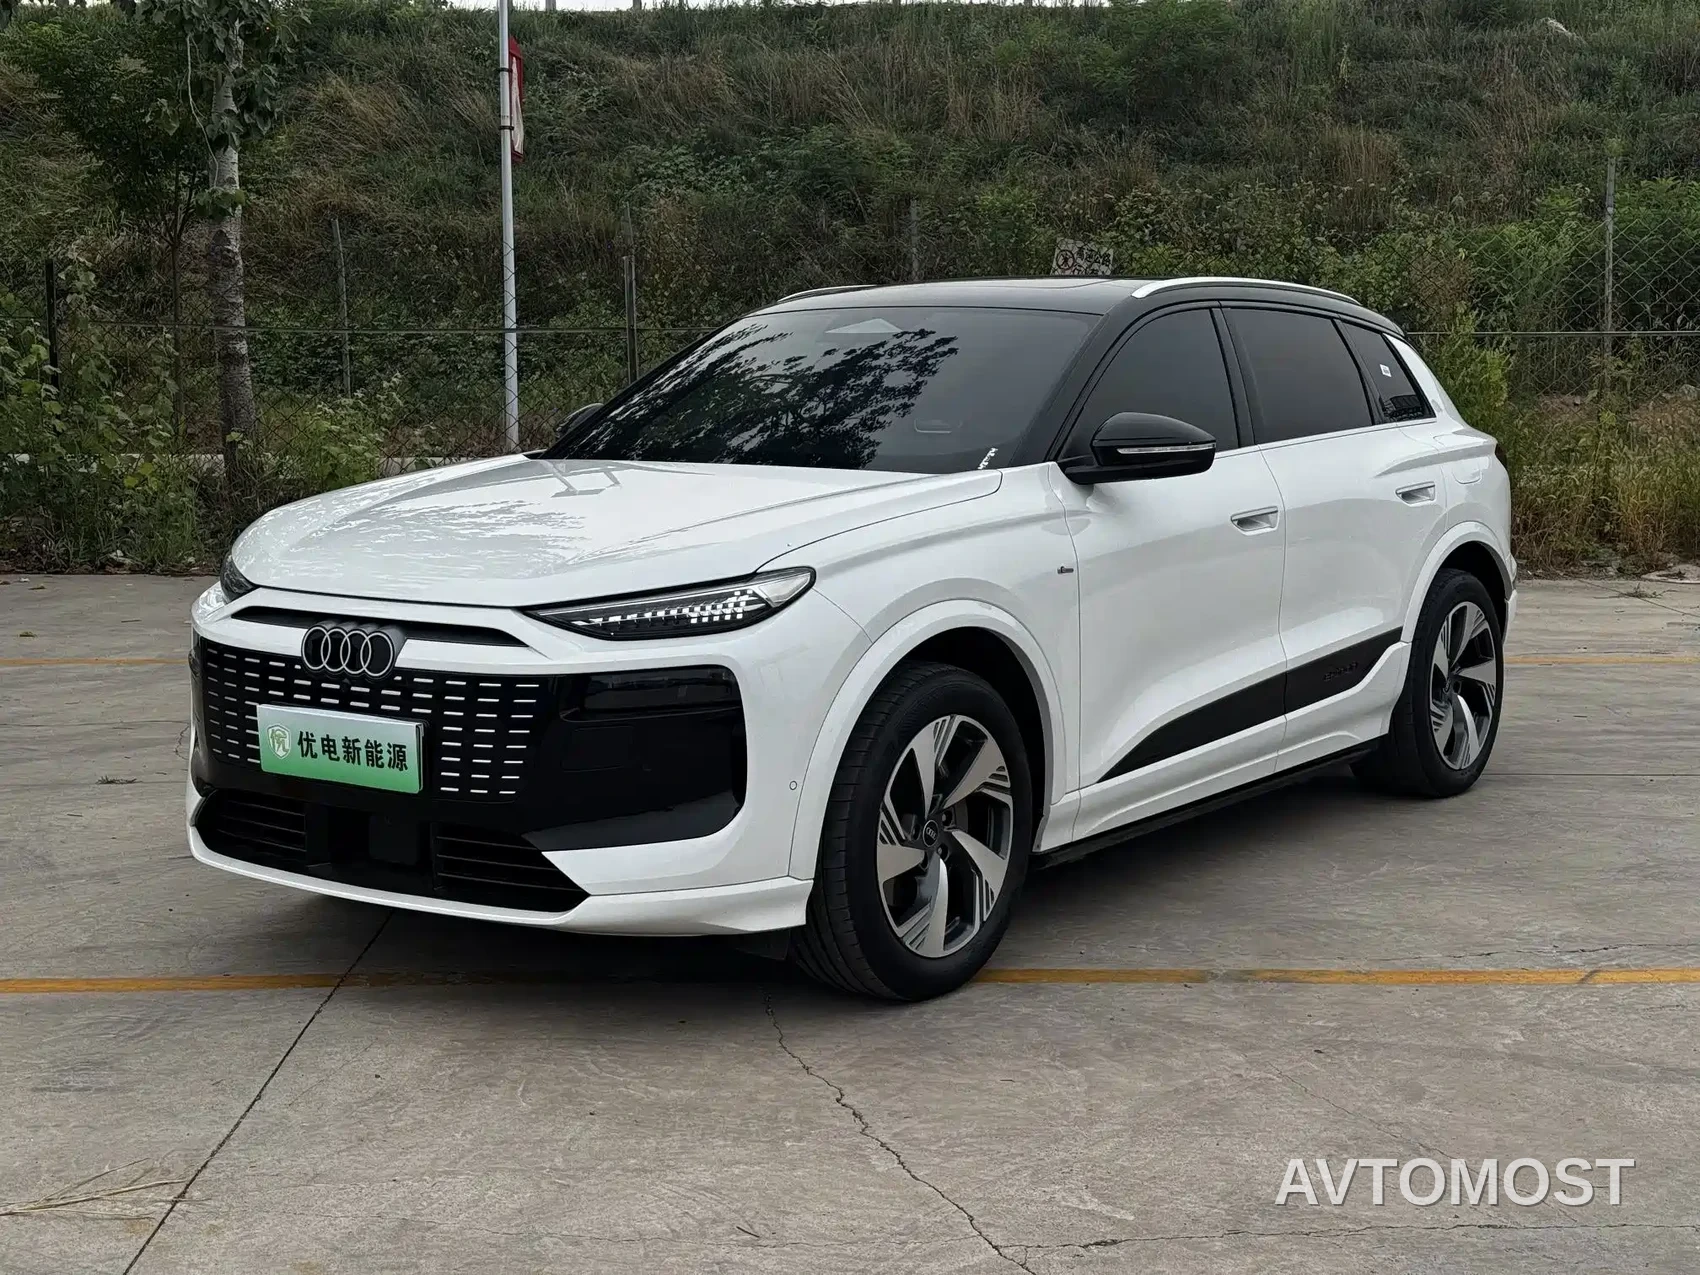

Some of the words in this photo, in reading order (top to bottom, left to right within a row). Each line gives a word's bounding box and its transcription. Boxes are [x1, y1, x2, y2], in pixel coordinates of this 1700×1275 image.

[297, 730, 409, 771] 优电新能源
